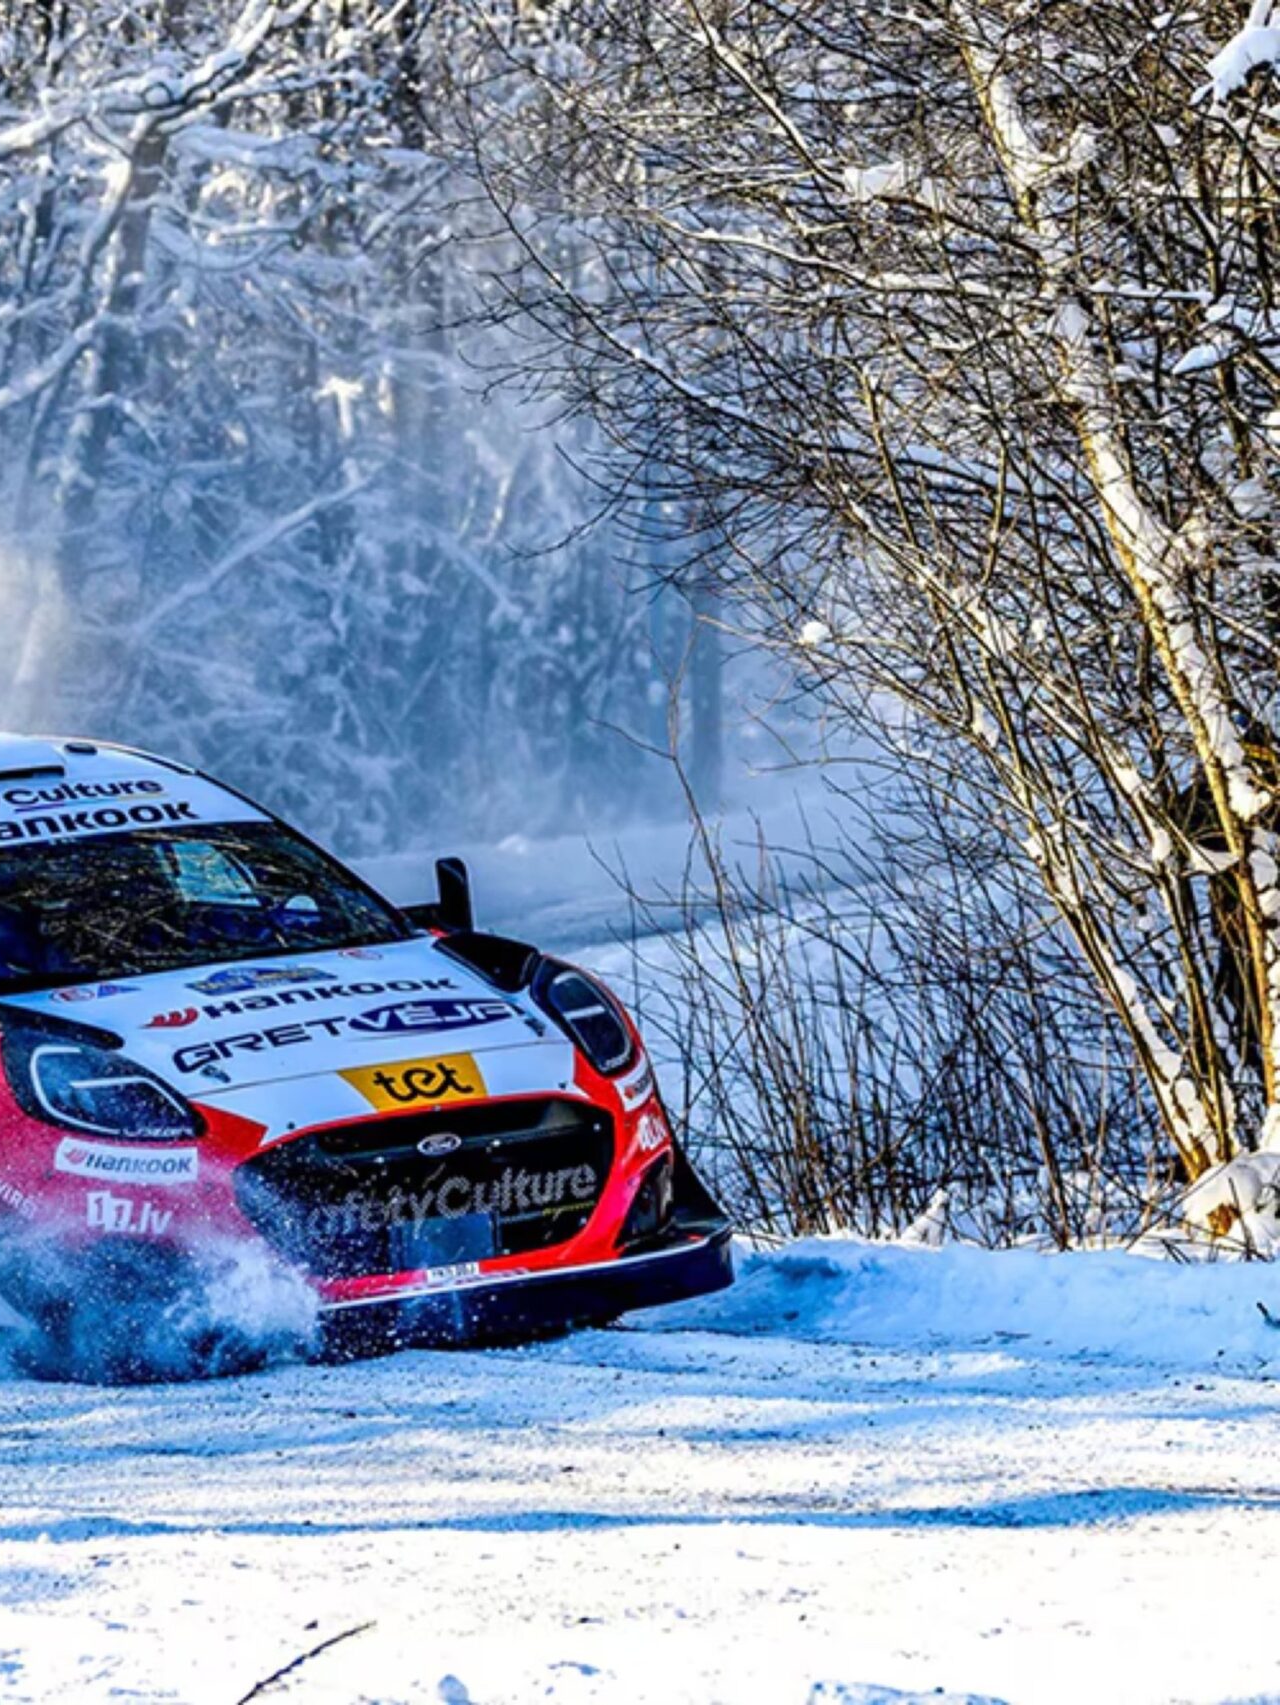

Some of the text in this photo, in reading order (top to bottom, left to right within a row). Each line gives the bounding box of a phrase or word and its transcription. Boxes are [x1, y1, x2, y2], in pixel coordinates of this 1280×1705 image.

[372, 1062, 474, 1101] tet
[86, 1190, 172, 1235] 11.lv
[308, 1162, 598, 1240] afetyCulture
